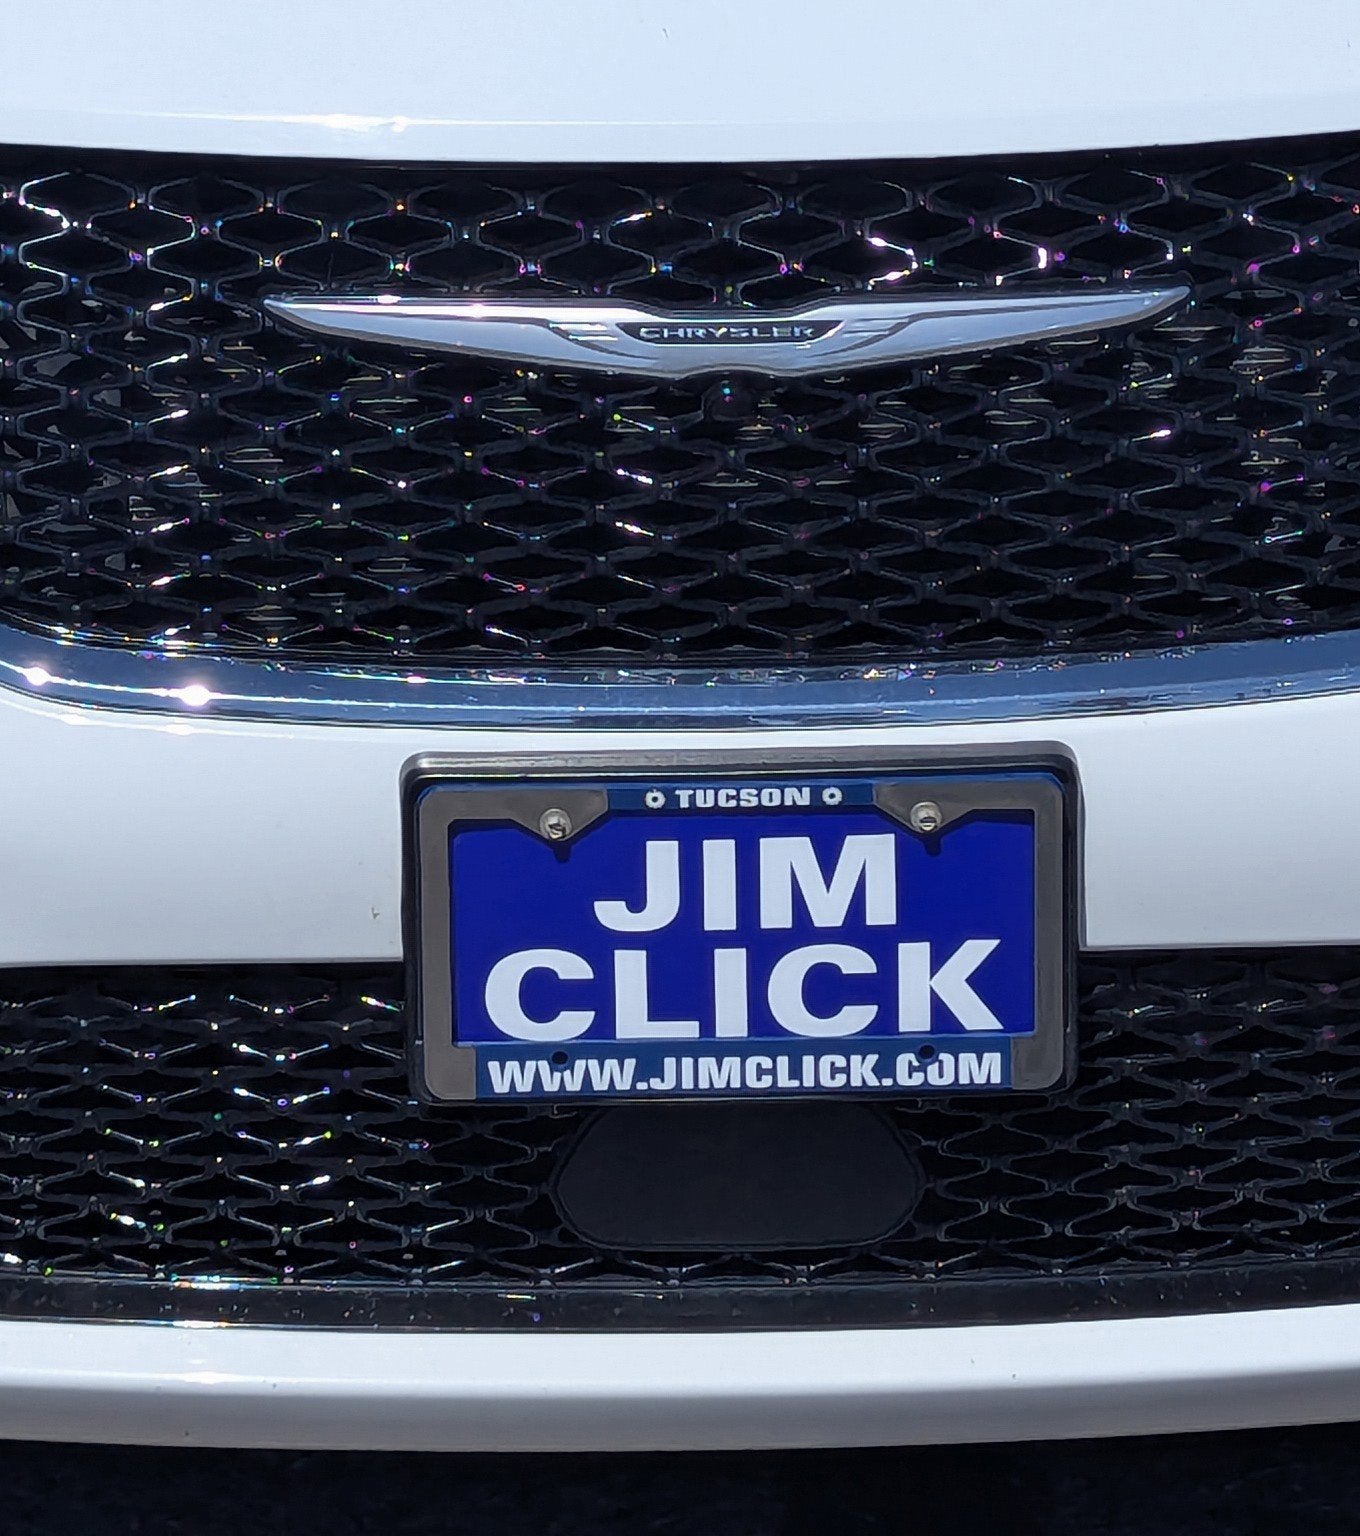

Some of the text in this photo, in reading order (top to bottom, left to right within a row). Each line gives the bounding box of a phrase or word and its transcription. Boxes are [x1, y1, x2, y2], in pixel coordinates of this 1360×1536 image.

[639, 325, 815, 340] CHRYSLER
[675, 787, 810, 808] TUCSON
[593, 833, 897, 932] JIM
[484, 938, 1004, 1042] CLICK
[487, 1052, 1002, 1094] WWW.JIMCLICK.COM
